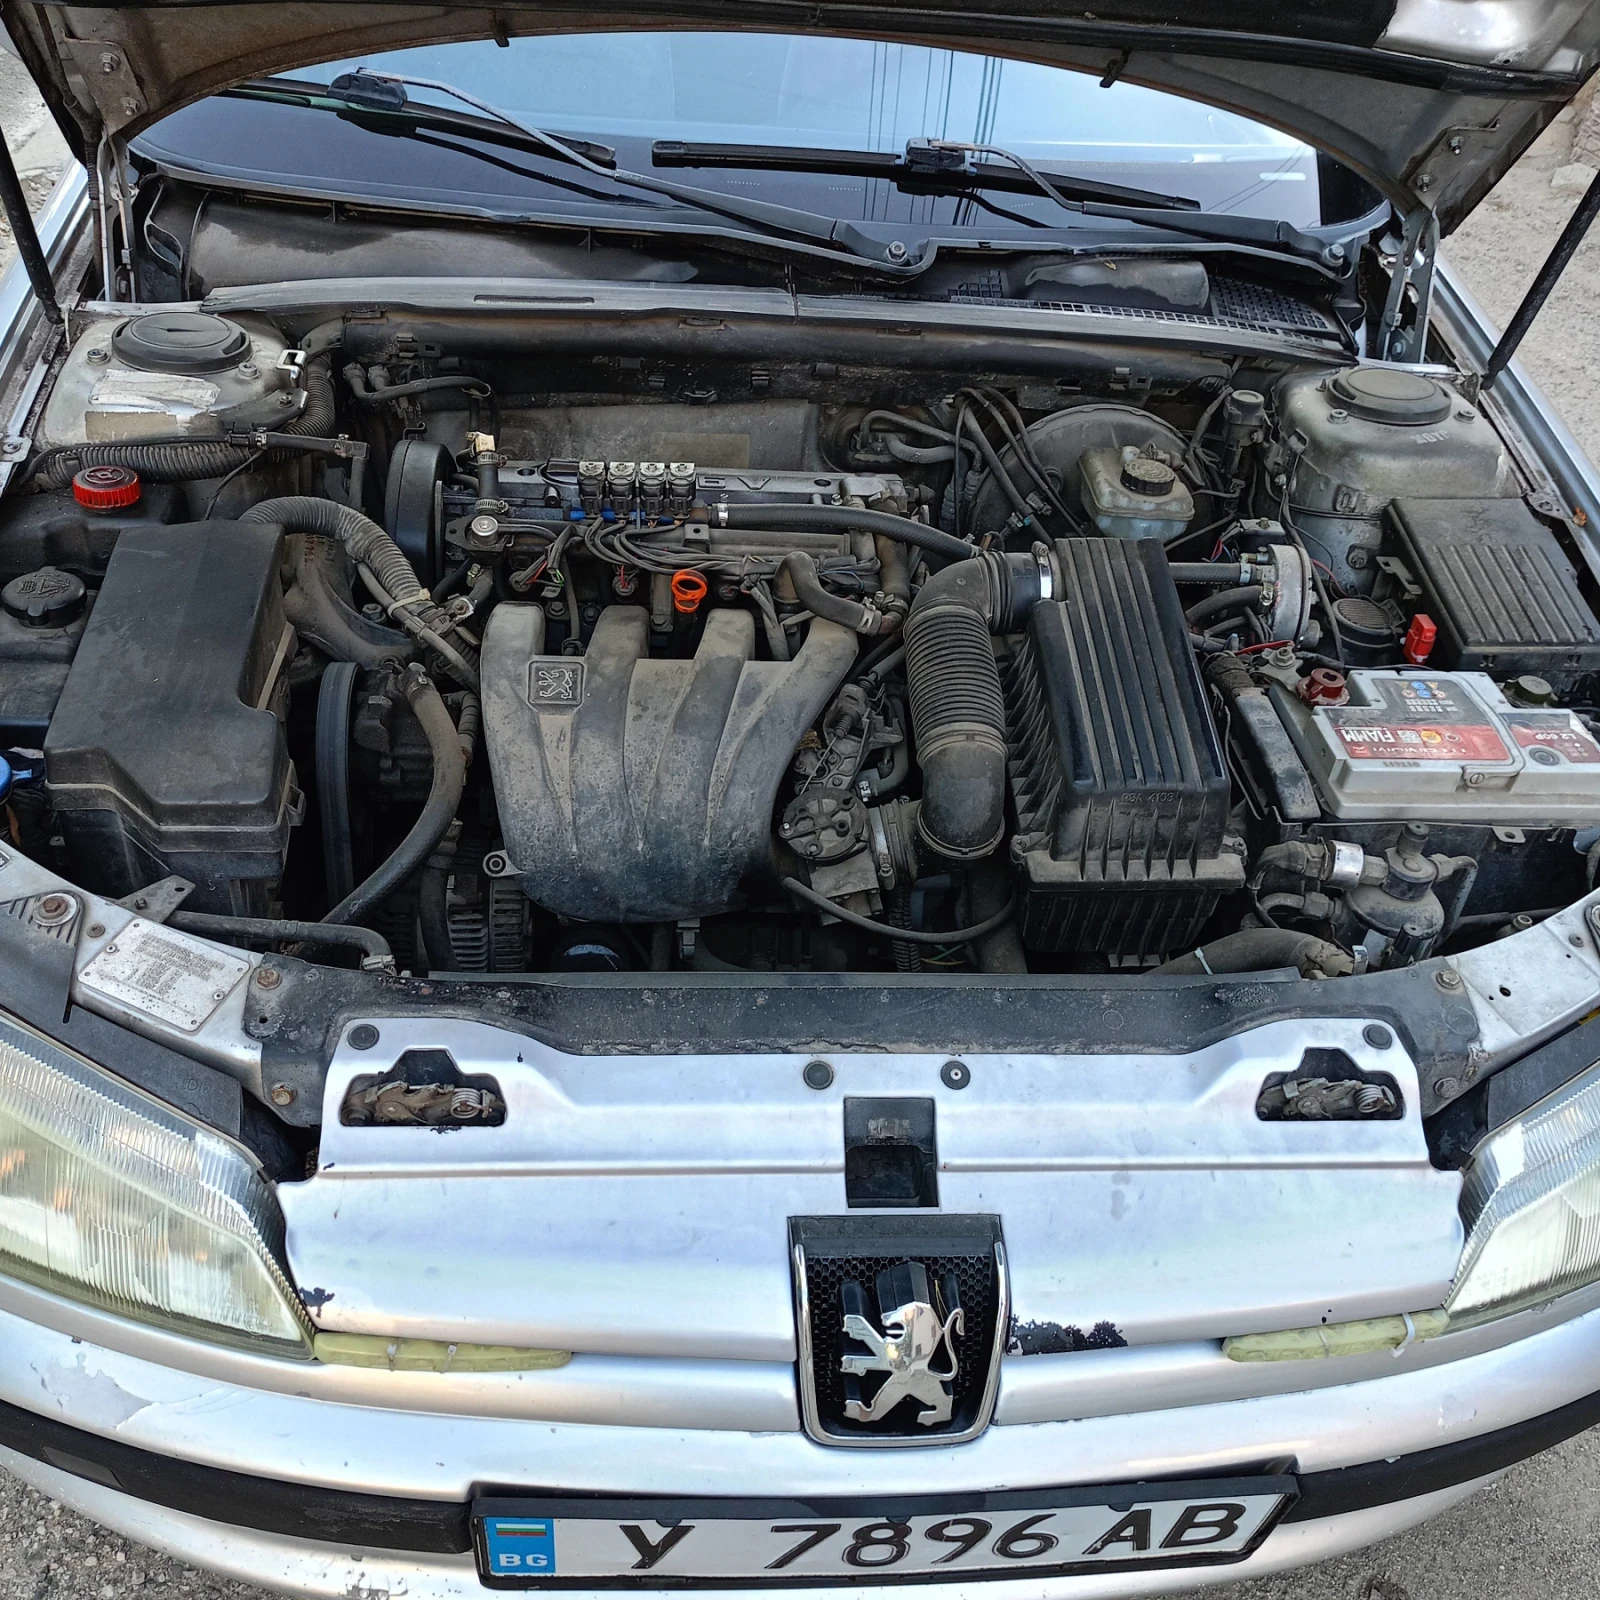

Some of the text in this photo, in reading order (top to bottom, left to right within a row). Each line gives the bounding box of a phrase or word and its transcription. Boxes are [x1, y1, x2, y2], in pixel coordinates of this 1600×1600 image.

[1340, 729, 1396, 743] FIAMM
[619, 1502, 1247, 1571] Y 7896 AB
[499, 1553, 548, 1567] BG
